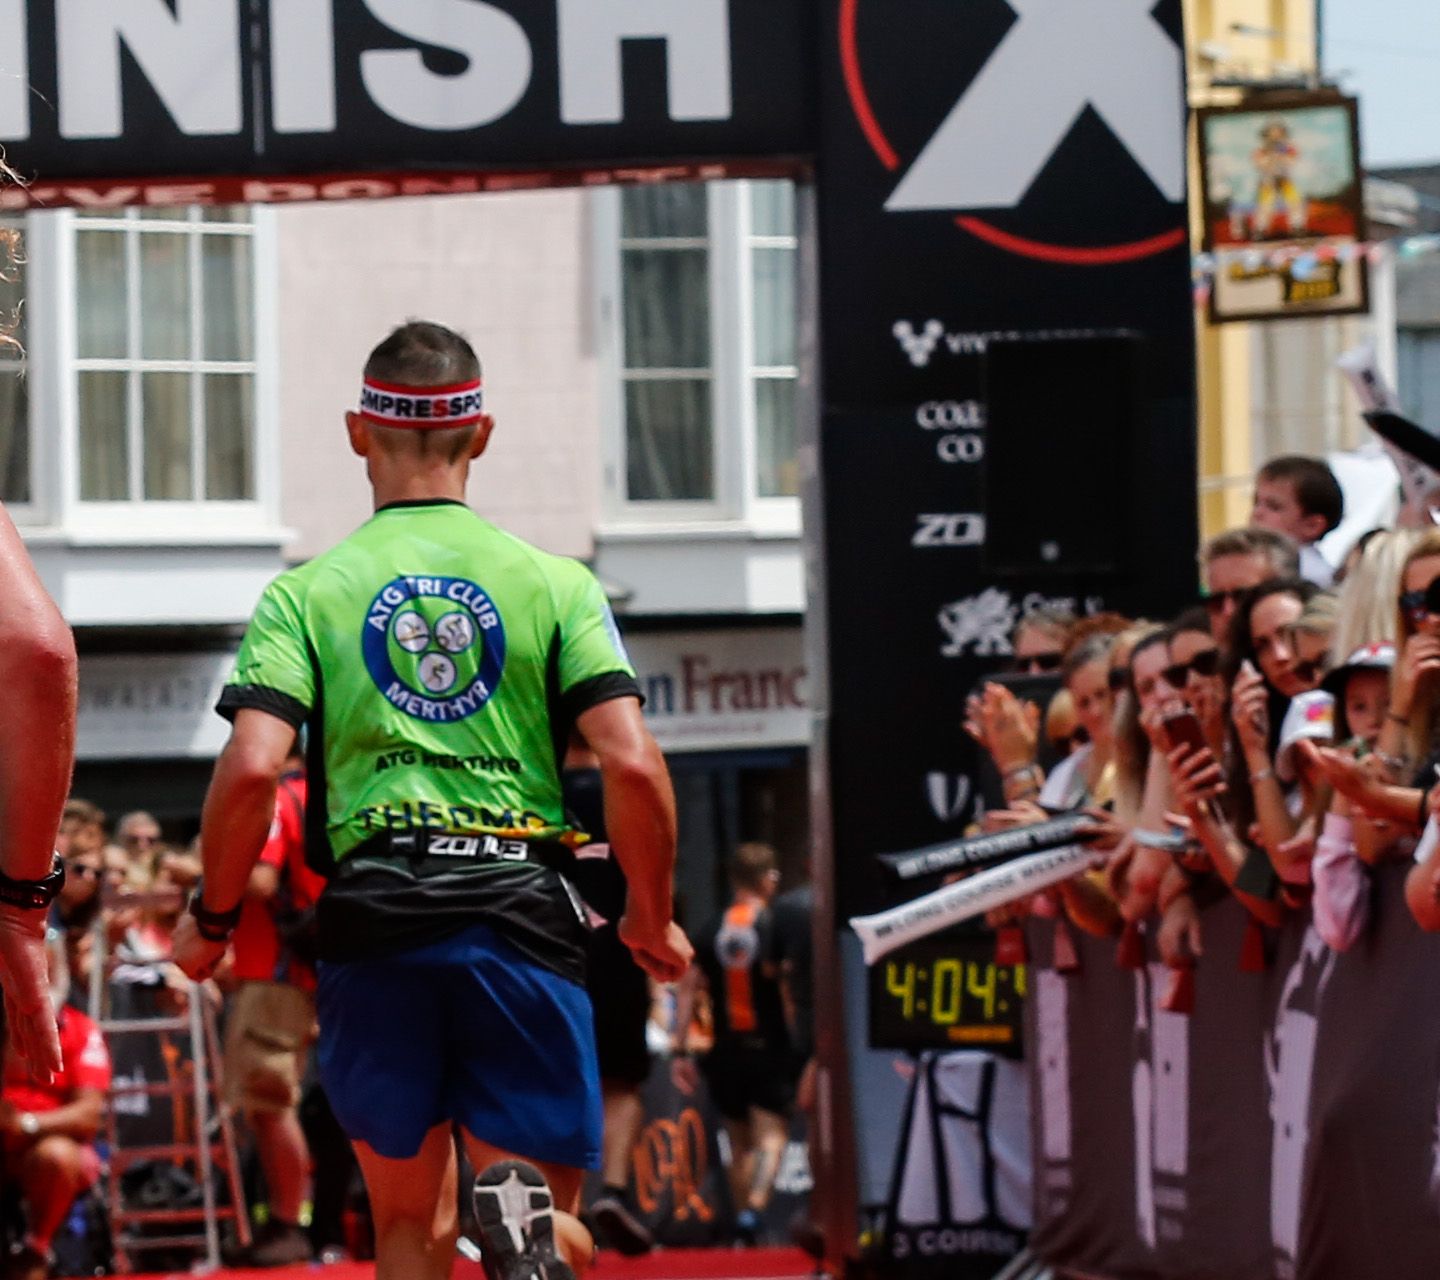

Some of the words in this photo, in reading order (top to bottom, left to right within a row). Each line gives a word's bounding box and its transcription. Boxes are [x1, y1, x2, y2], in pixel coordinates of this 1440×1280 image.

[368, 585, 404, 632] ATG
[446, 581, 498, 631] CLUB
[385, 680, 489, 721] MERTHYR
[681, 653, 808, 715] Franc
[375, 749, 416, 772] ATG
